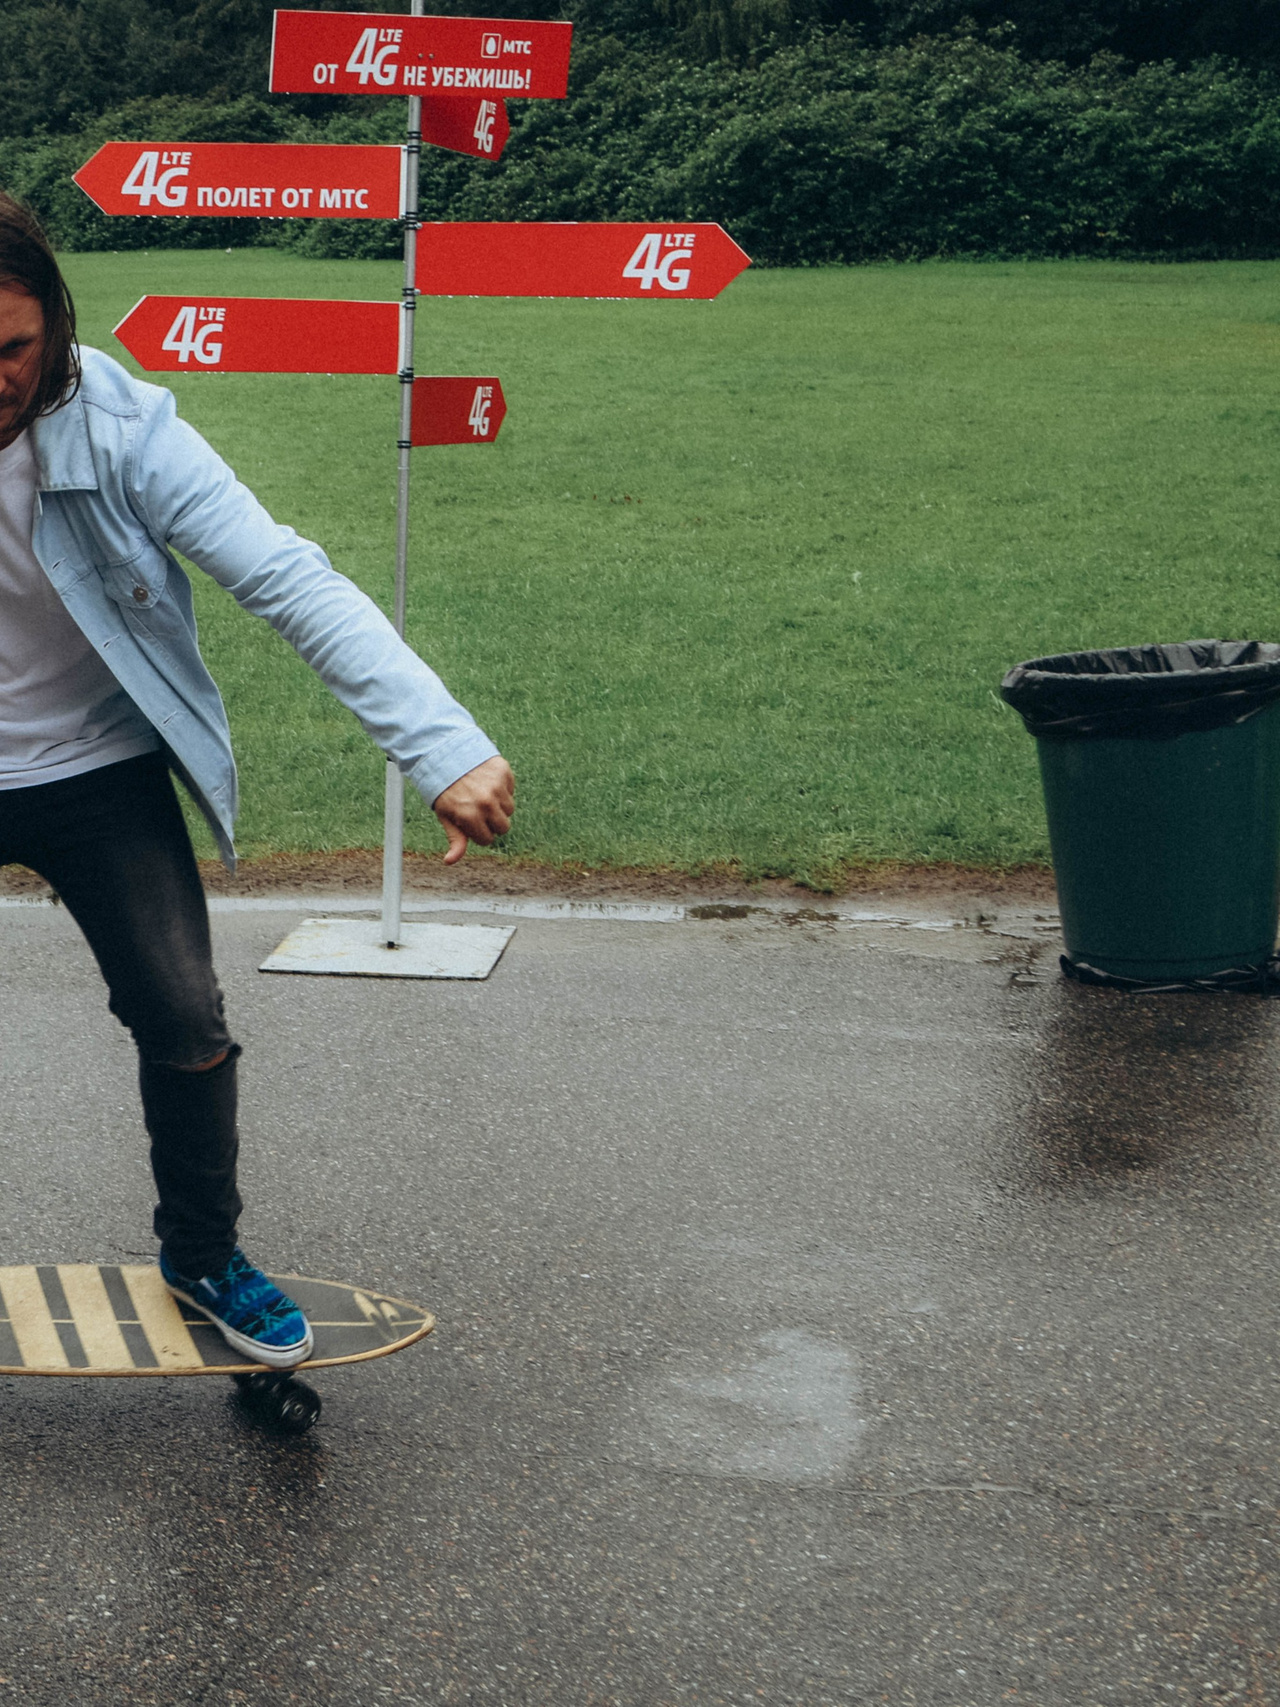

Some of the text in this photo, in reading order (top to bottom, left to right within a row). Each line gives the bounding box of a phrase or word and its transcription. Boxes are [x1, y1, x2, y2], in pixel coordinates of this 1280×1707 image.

[313, 28, 532, 90] ОТ 4G НЕ УБЕЖИШЬ!
[378, 28, 403, 43] LTE
[503, 39, 532, 55] МТС
[473, 100, 495, 153] 4G
[121, 151, 369, 209] 4G ПОЛЕТ ОТ МТС
[161, 152, 192, 165] LTE
[622, 233, 692, 291] 4G
[664, 234, 696, 247] LTE
[161, 306, 223, 364] 4G
[198, 307, 227, 321] LTE
[468, 386, 491, 436] 4G
